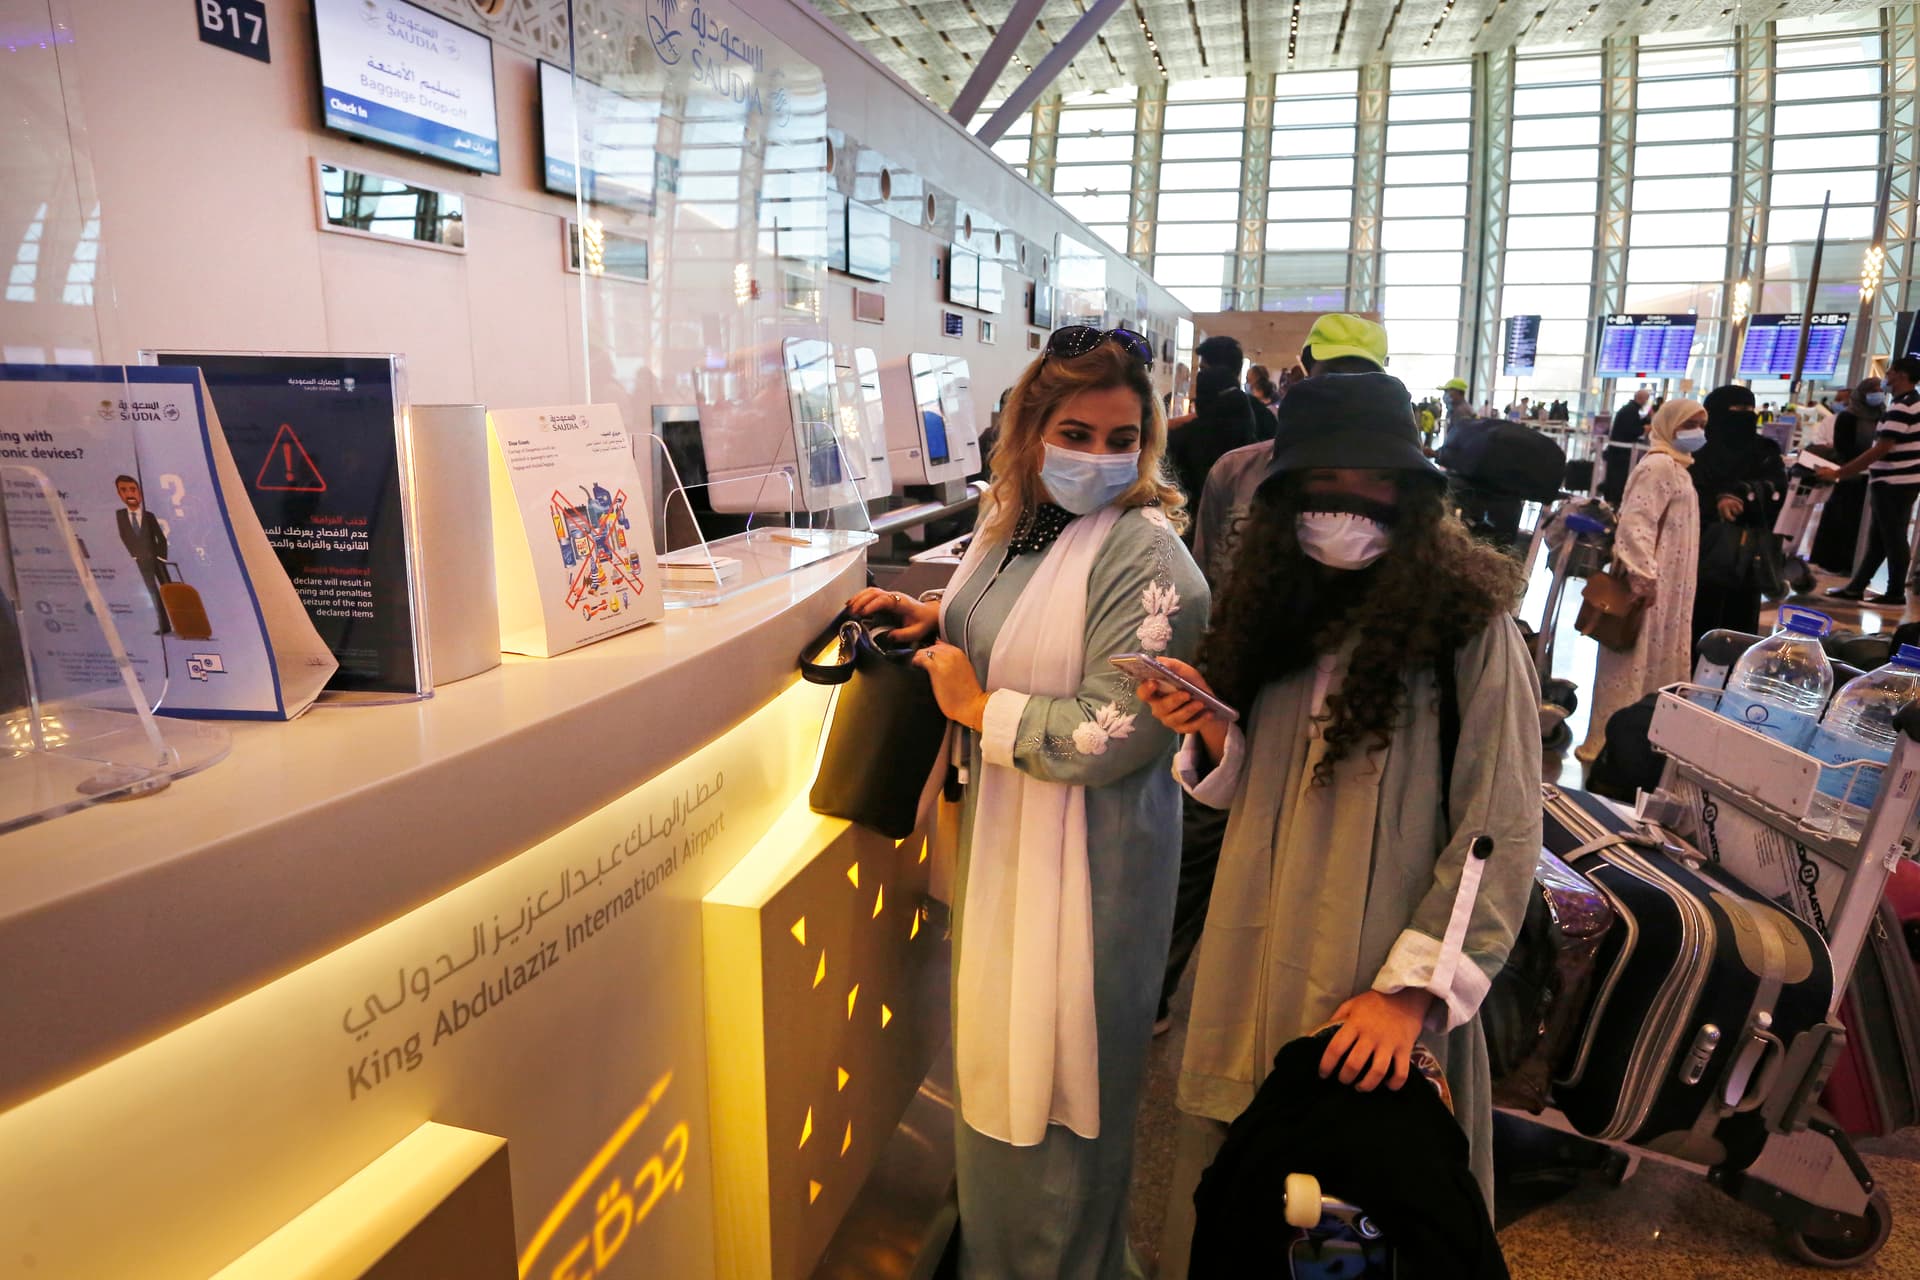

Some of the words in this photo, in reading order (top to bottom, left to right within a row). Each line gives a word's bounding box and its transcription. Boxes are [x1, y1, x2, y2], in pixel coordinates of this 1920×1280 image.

[201, 0, 263, 45] B17
[387, 8, 438, 39] السعودية
[387, 26, 439, 54] SAUDIA
[690, 1, 763, 73] السعودية
[360, 74, 416, 103] Baggage
[420, 80, 460, 98] تسليم
[692, 49, 763, 115] SAUDIA
[330, 98, 357, 115] Check
[119, 400, 159, 411] السعوية
[552, 423, 579, 432] SAUDIA
[24, 431, 53, 442] with
[31, 448, 84, 459] devices?
[284, 526, 313, 538] يعرضك
[350, 530, 368, 539] عدم
[297, 540, 331, 551] والغرامة
[333, 541, 369, 551] القانونية
[293, 577, 322, 585] declare
[320, 588, 334, 596] and
[336, 589, 372, 597] penalties
[303, 598, 331, 606] seizure
[342, 599, 356, 607] the
[682, 771, 724, 826] مطار
[624, 797, 680, 857] الملك
[347, 1031, 424, 1101] King
[433, 940, 560, 1047] Abdulaziz
[566, 855, 678, 953] International
[683, 811, 726, 865] Airport
[342, 924, 486, 1042] الدولي
